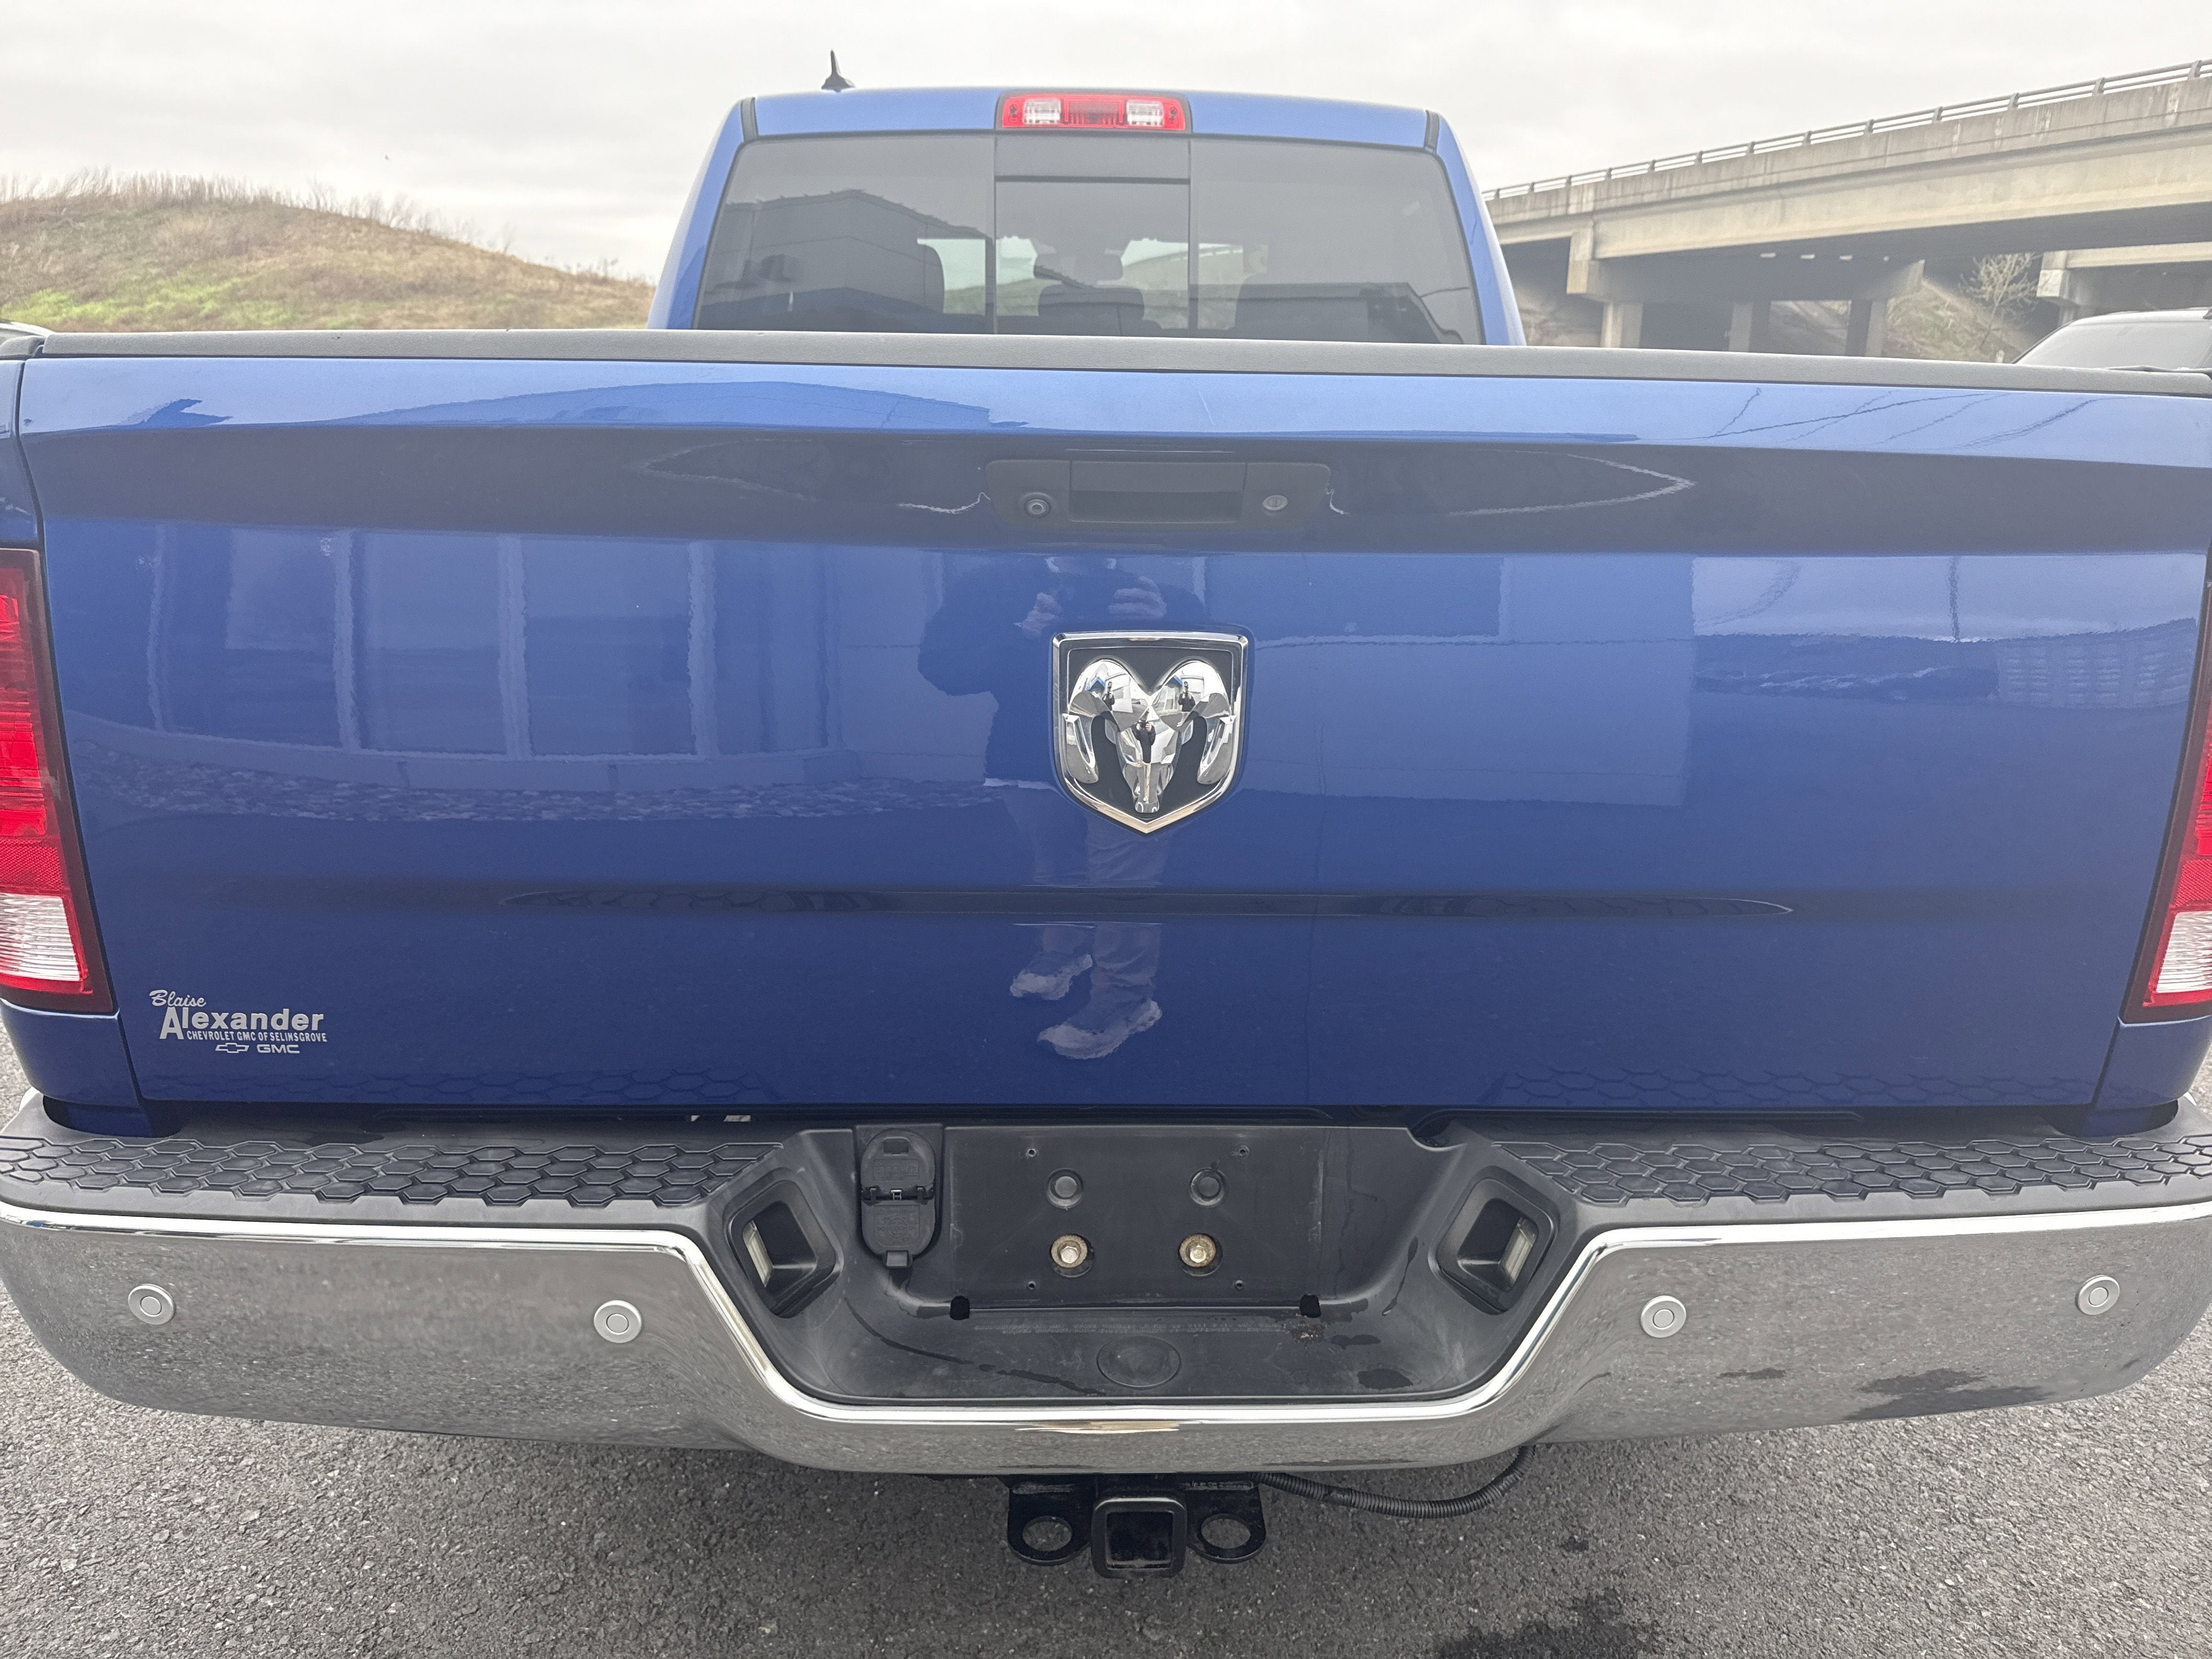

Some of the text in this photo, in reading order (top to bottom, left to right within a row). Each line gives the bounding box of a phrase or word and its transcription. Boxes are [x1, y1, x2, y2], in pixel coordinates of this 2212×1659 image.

[149, 989, 207, 1007] Blaise
[160, 1007, 324, 1040] Alexander
[187, 1030, 328, 1042] CHEVROLET GMC OF SELINSGROVE
[256, 1044, 300, 1054] GMC
